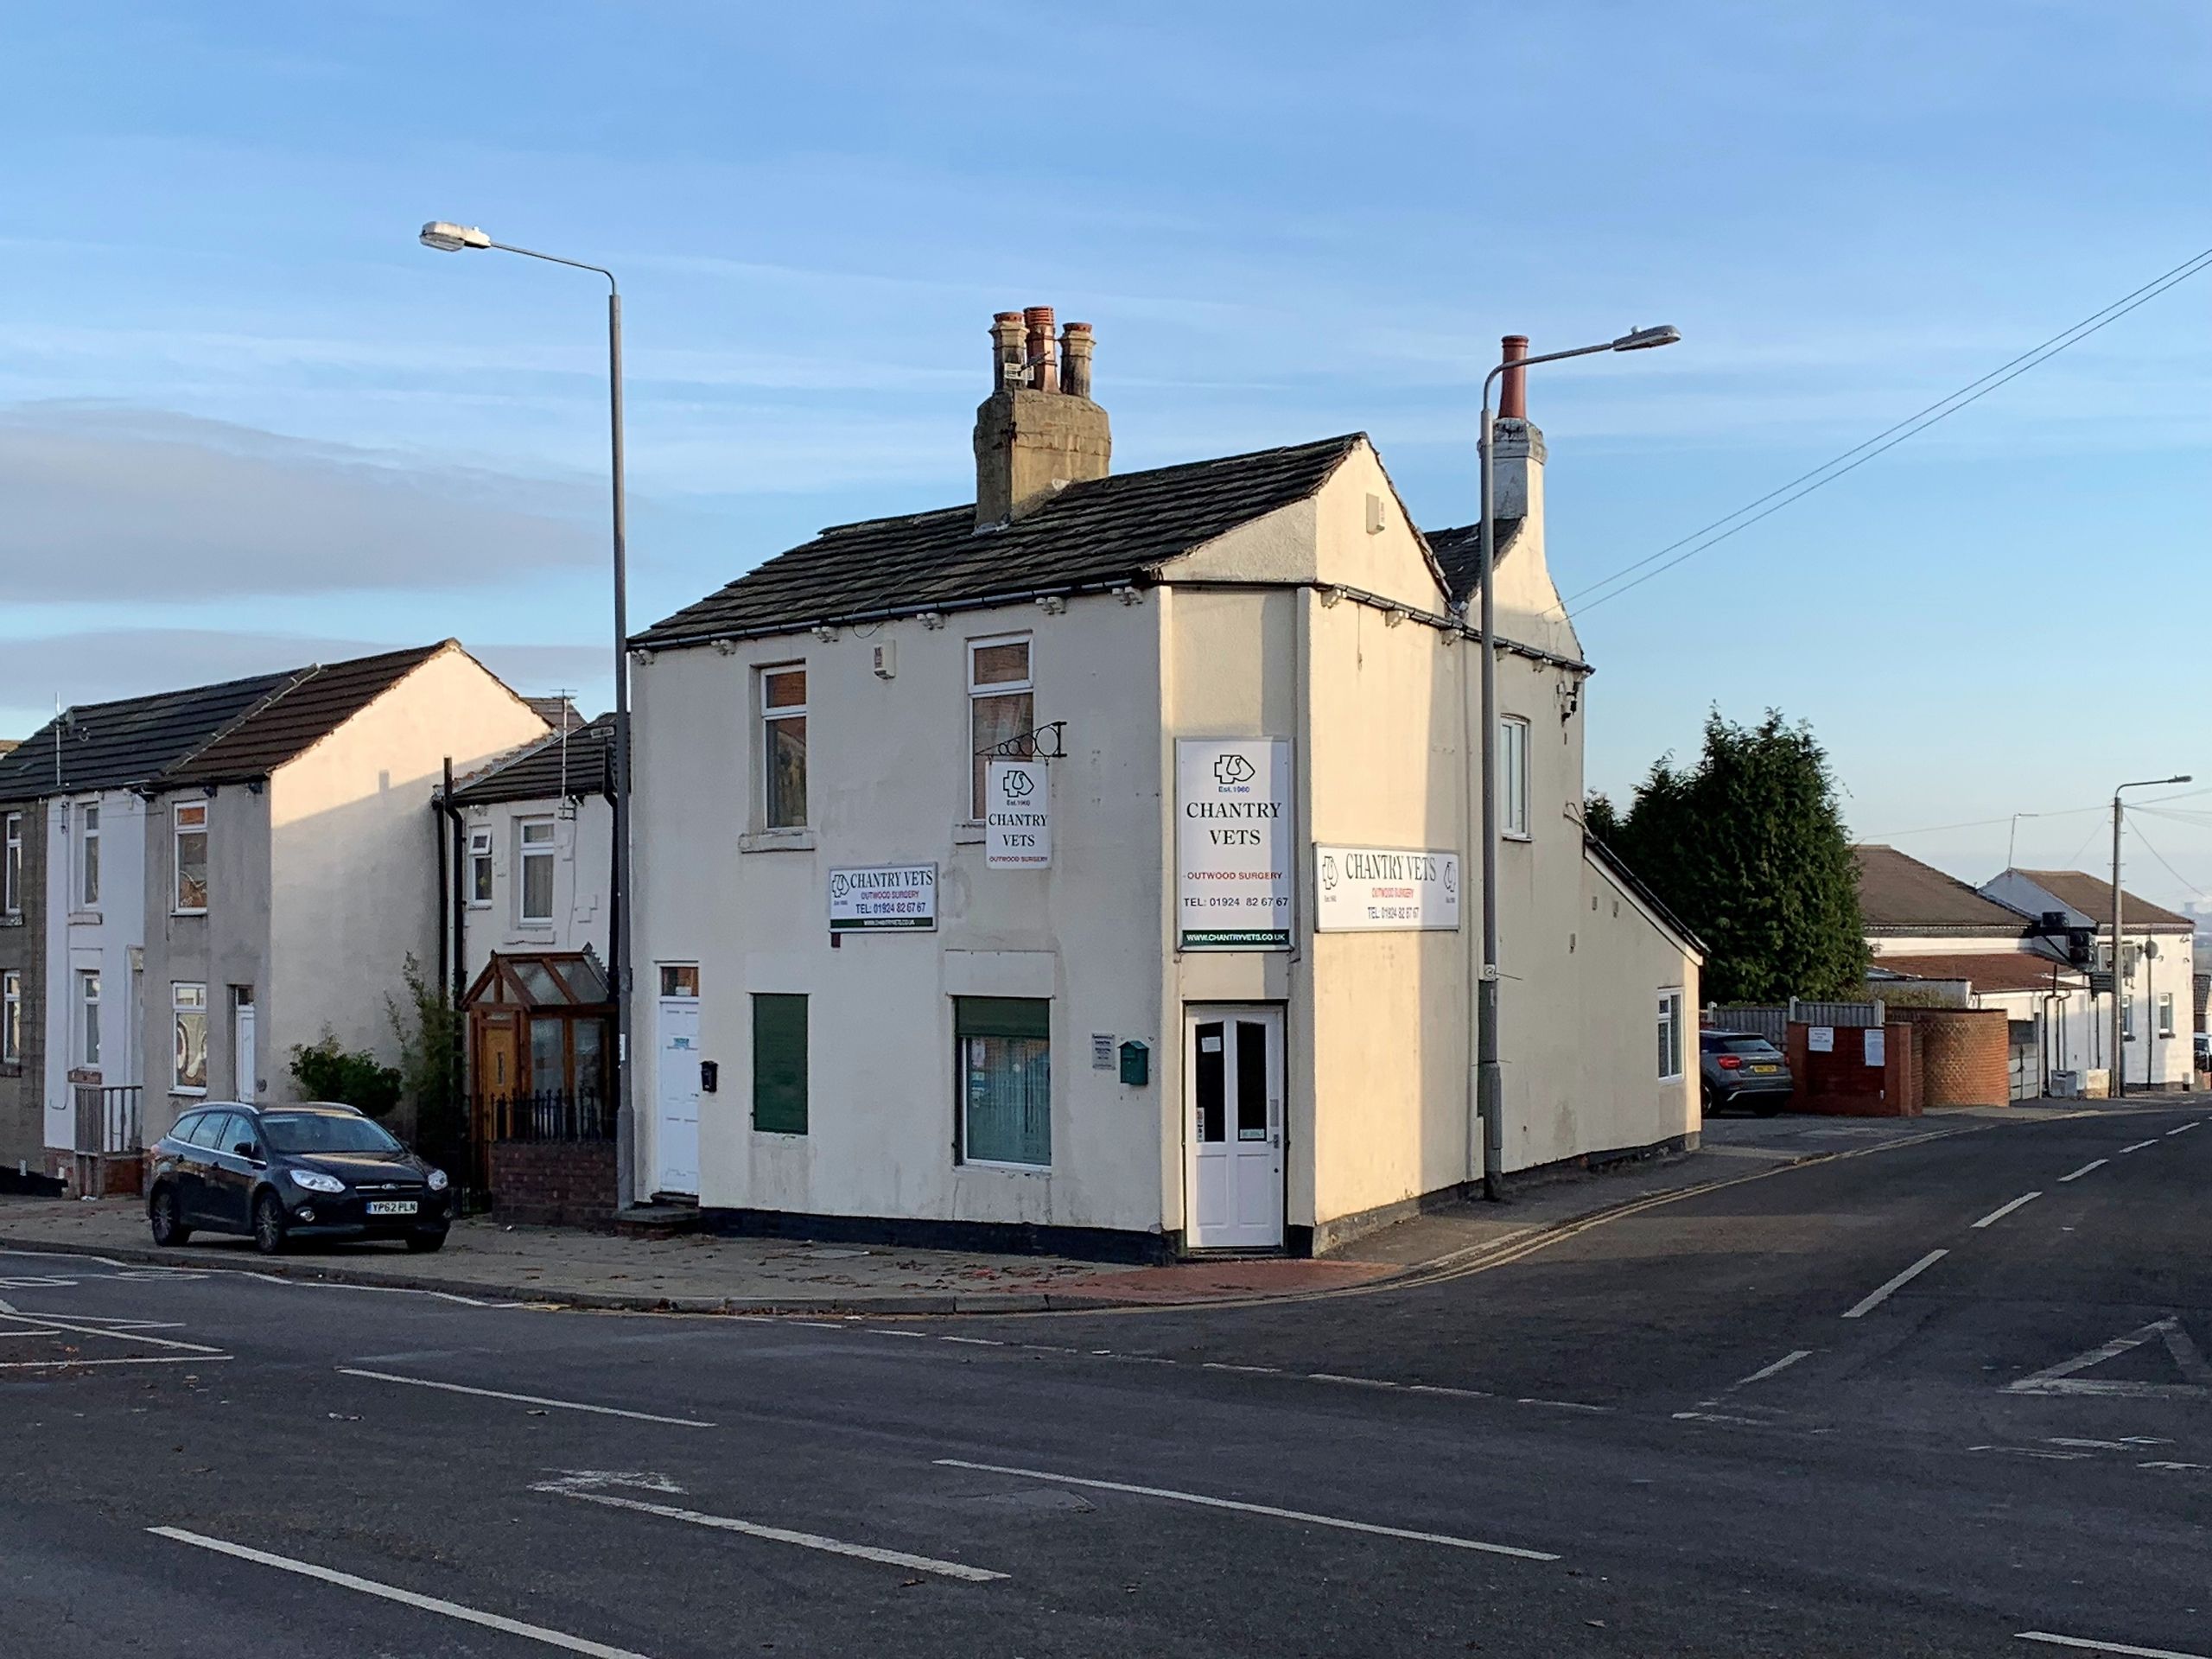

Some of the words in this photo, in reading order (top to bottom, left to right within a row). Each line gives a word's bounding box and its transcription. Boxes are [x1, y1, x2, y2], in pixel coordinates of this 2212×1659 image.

[1186, 802, 1282, 818] CHANTRY
[988, 813, 1048, 827] CHANTRY
[1002, 835, 1035, 847] VETS
[1210, 830, 1261, 845] VETS
[1345, 853, 1403, 880] CHANTRY
[1406, 855, 1437, 881] VETS
[850, 872, 901, 888] CHANTRY
[904, 870, 933, 887] VETS
[874, 902, 894, 913] 01924
[896, 902, 906, 912] 82
[917, 902, 926, 912] 67
[1210, 898, 1240, 906] 01924
[1246, 898, 1258, 906] 82
[1262, 898, 1274, 906] 67
[1275, 898, 1288, 906] 67
[373, 1202, 397, 1212] YP62
[398, 1202, 416, 1212] PLN
